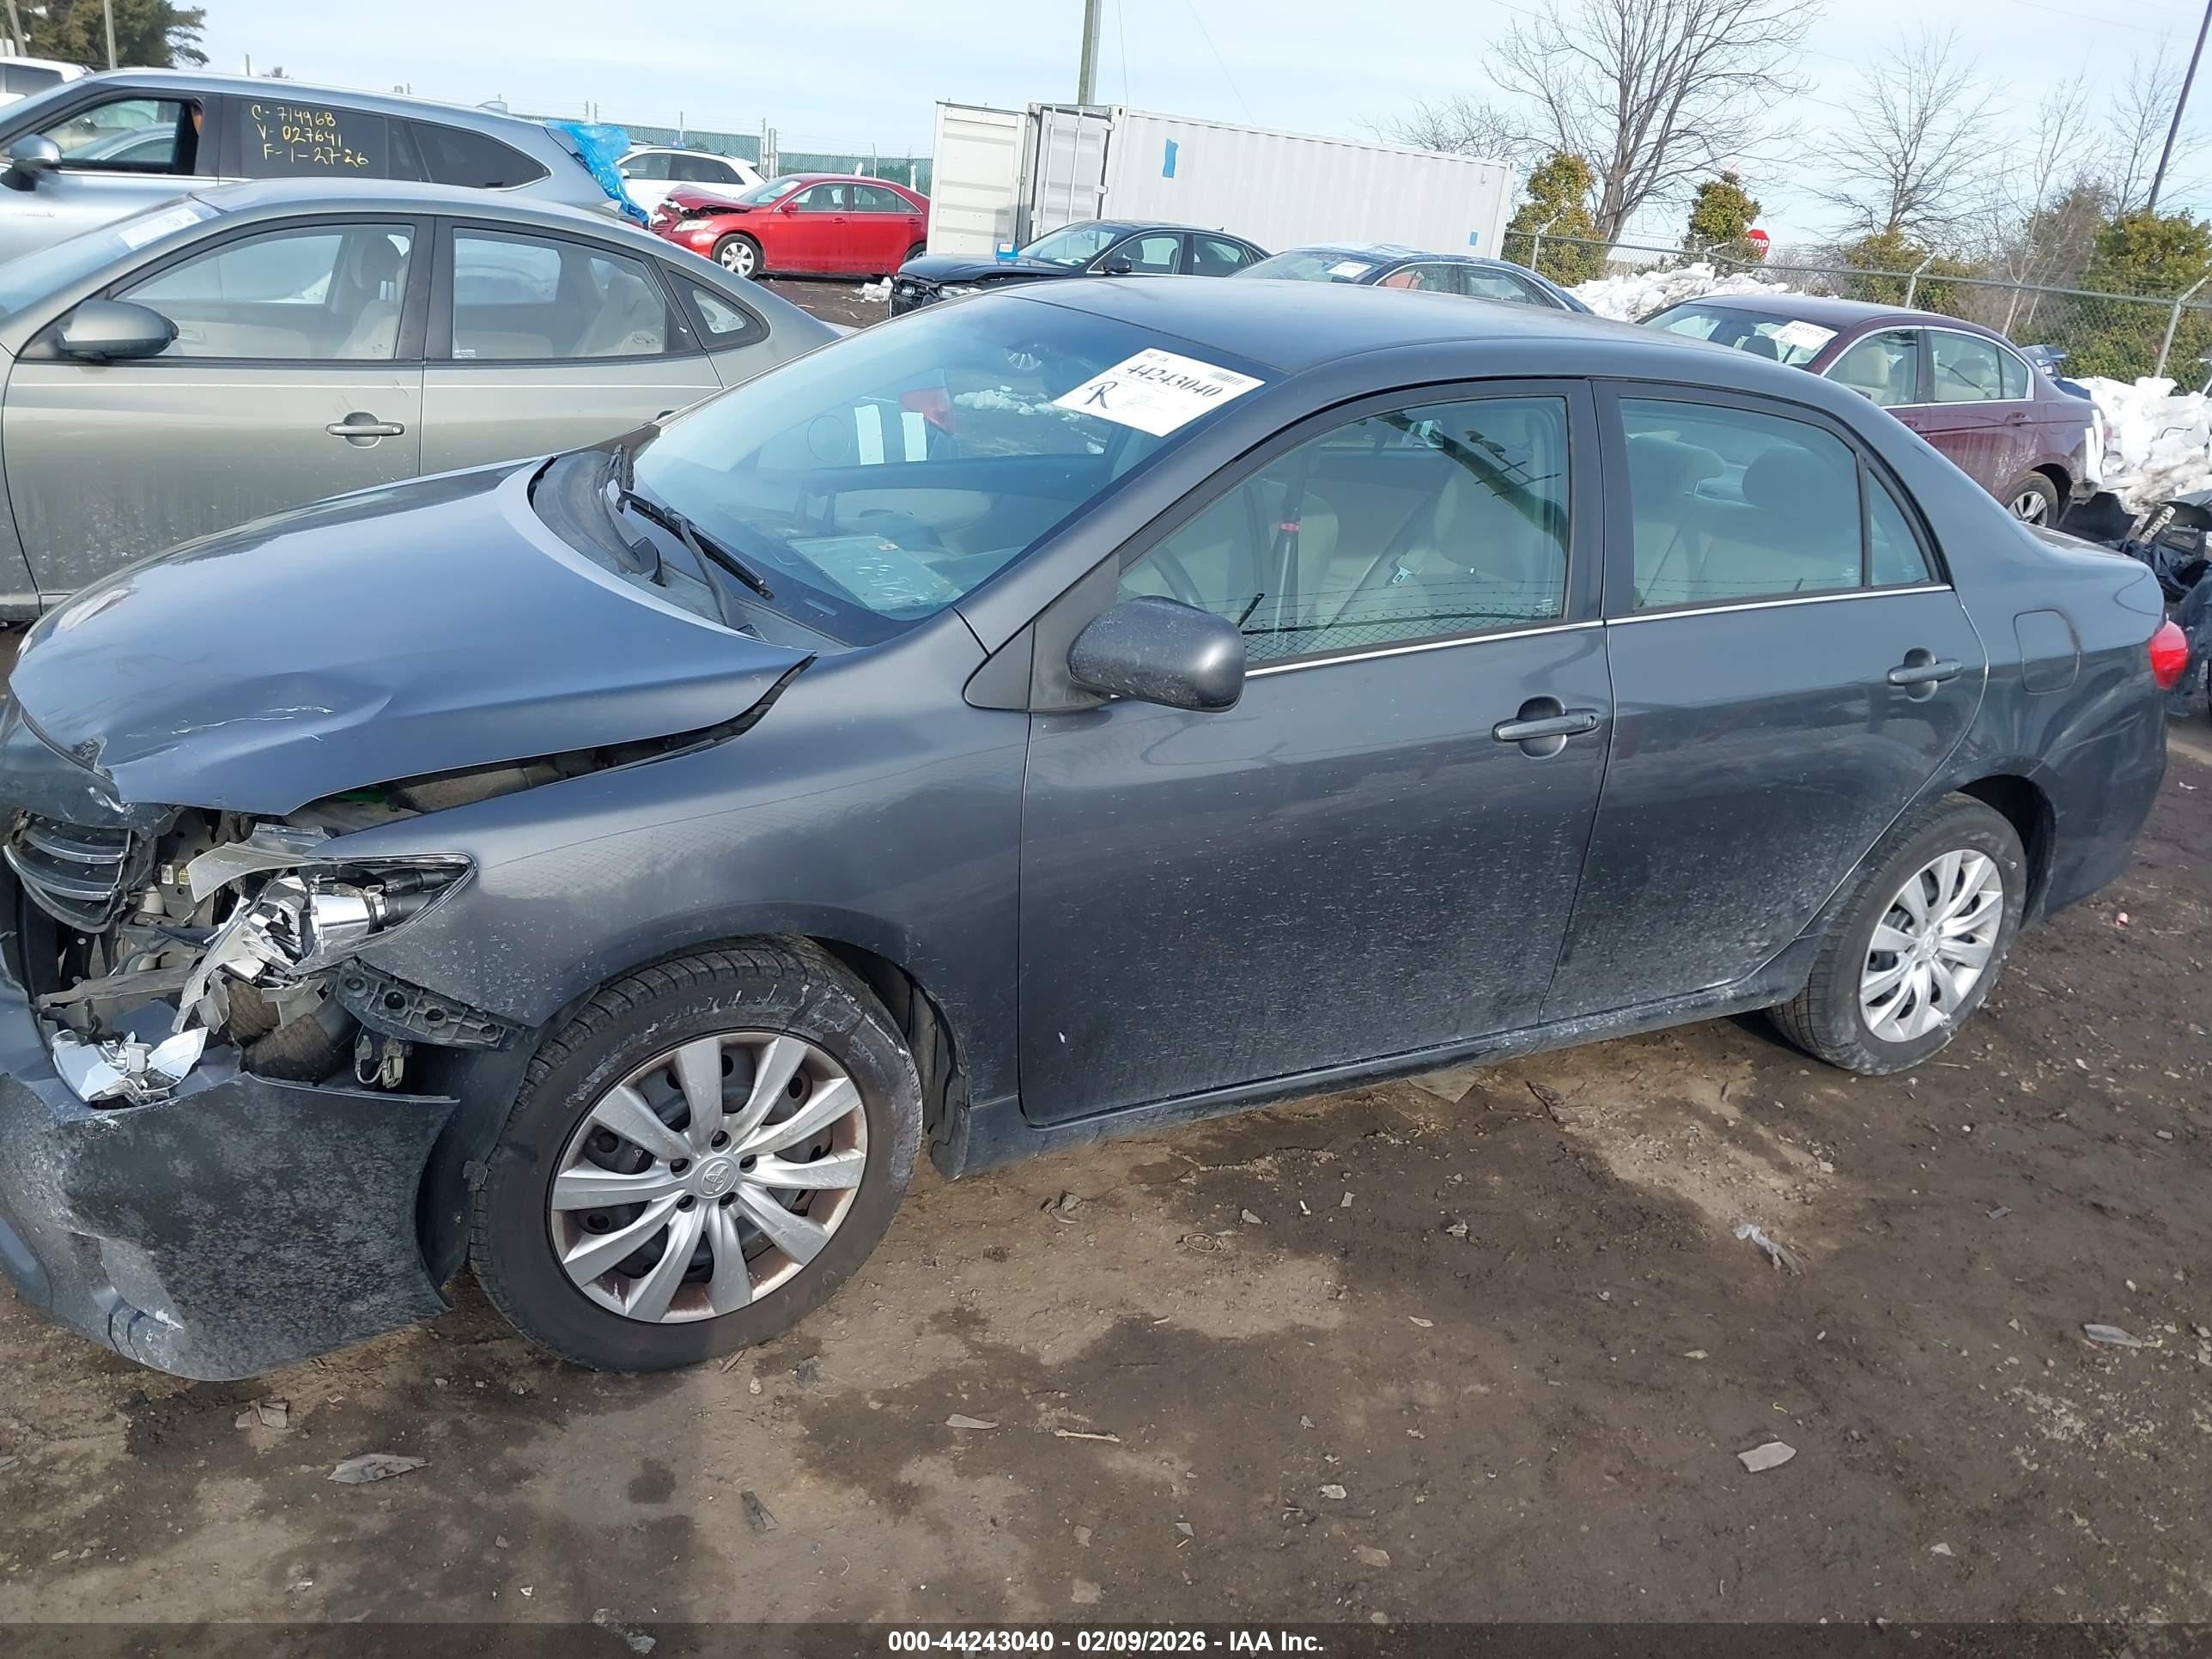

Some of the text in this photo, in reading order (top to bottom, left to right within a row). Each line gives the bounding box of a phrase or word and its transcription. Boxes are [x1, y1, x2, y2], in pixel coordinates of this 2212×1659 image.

[276, 106, 337, 127] 714968
[282, 125, 342, 148] 027641
[1126, 363, 1224, 398] 44243040
[1083, 380, 1119, 410] R
